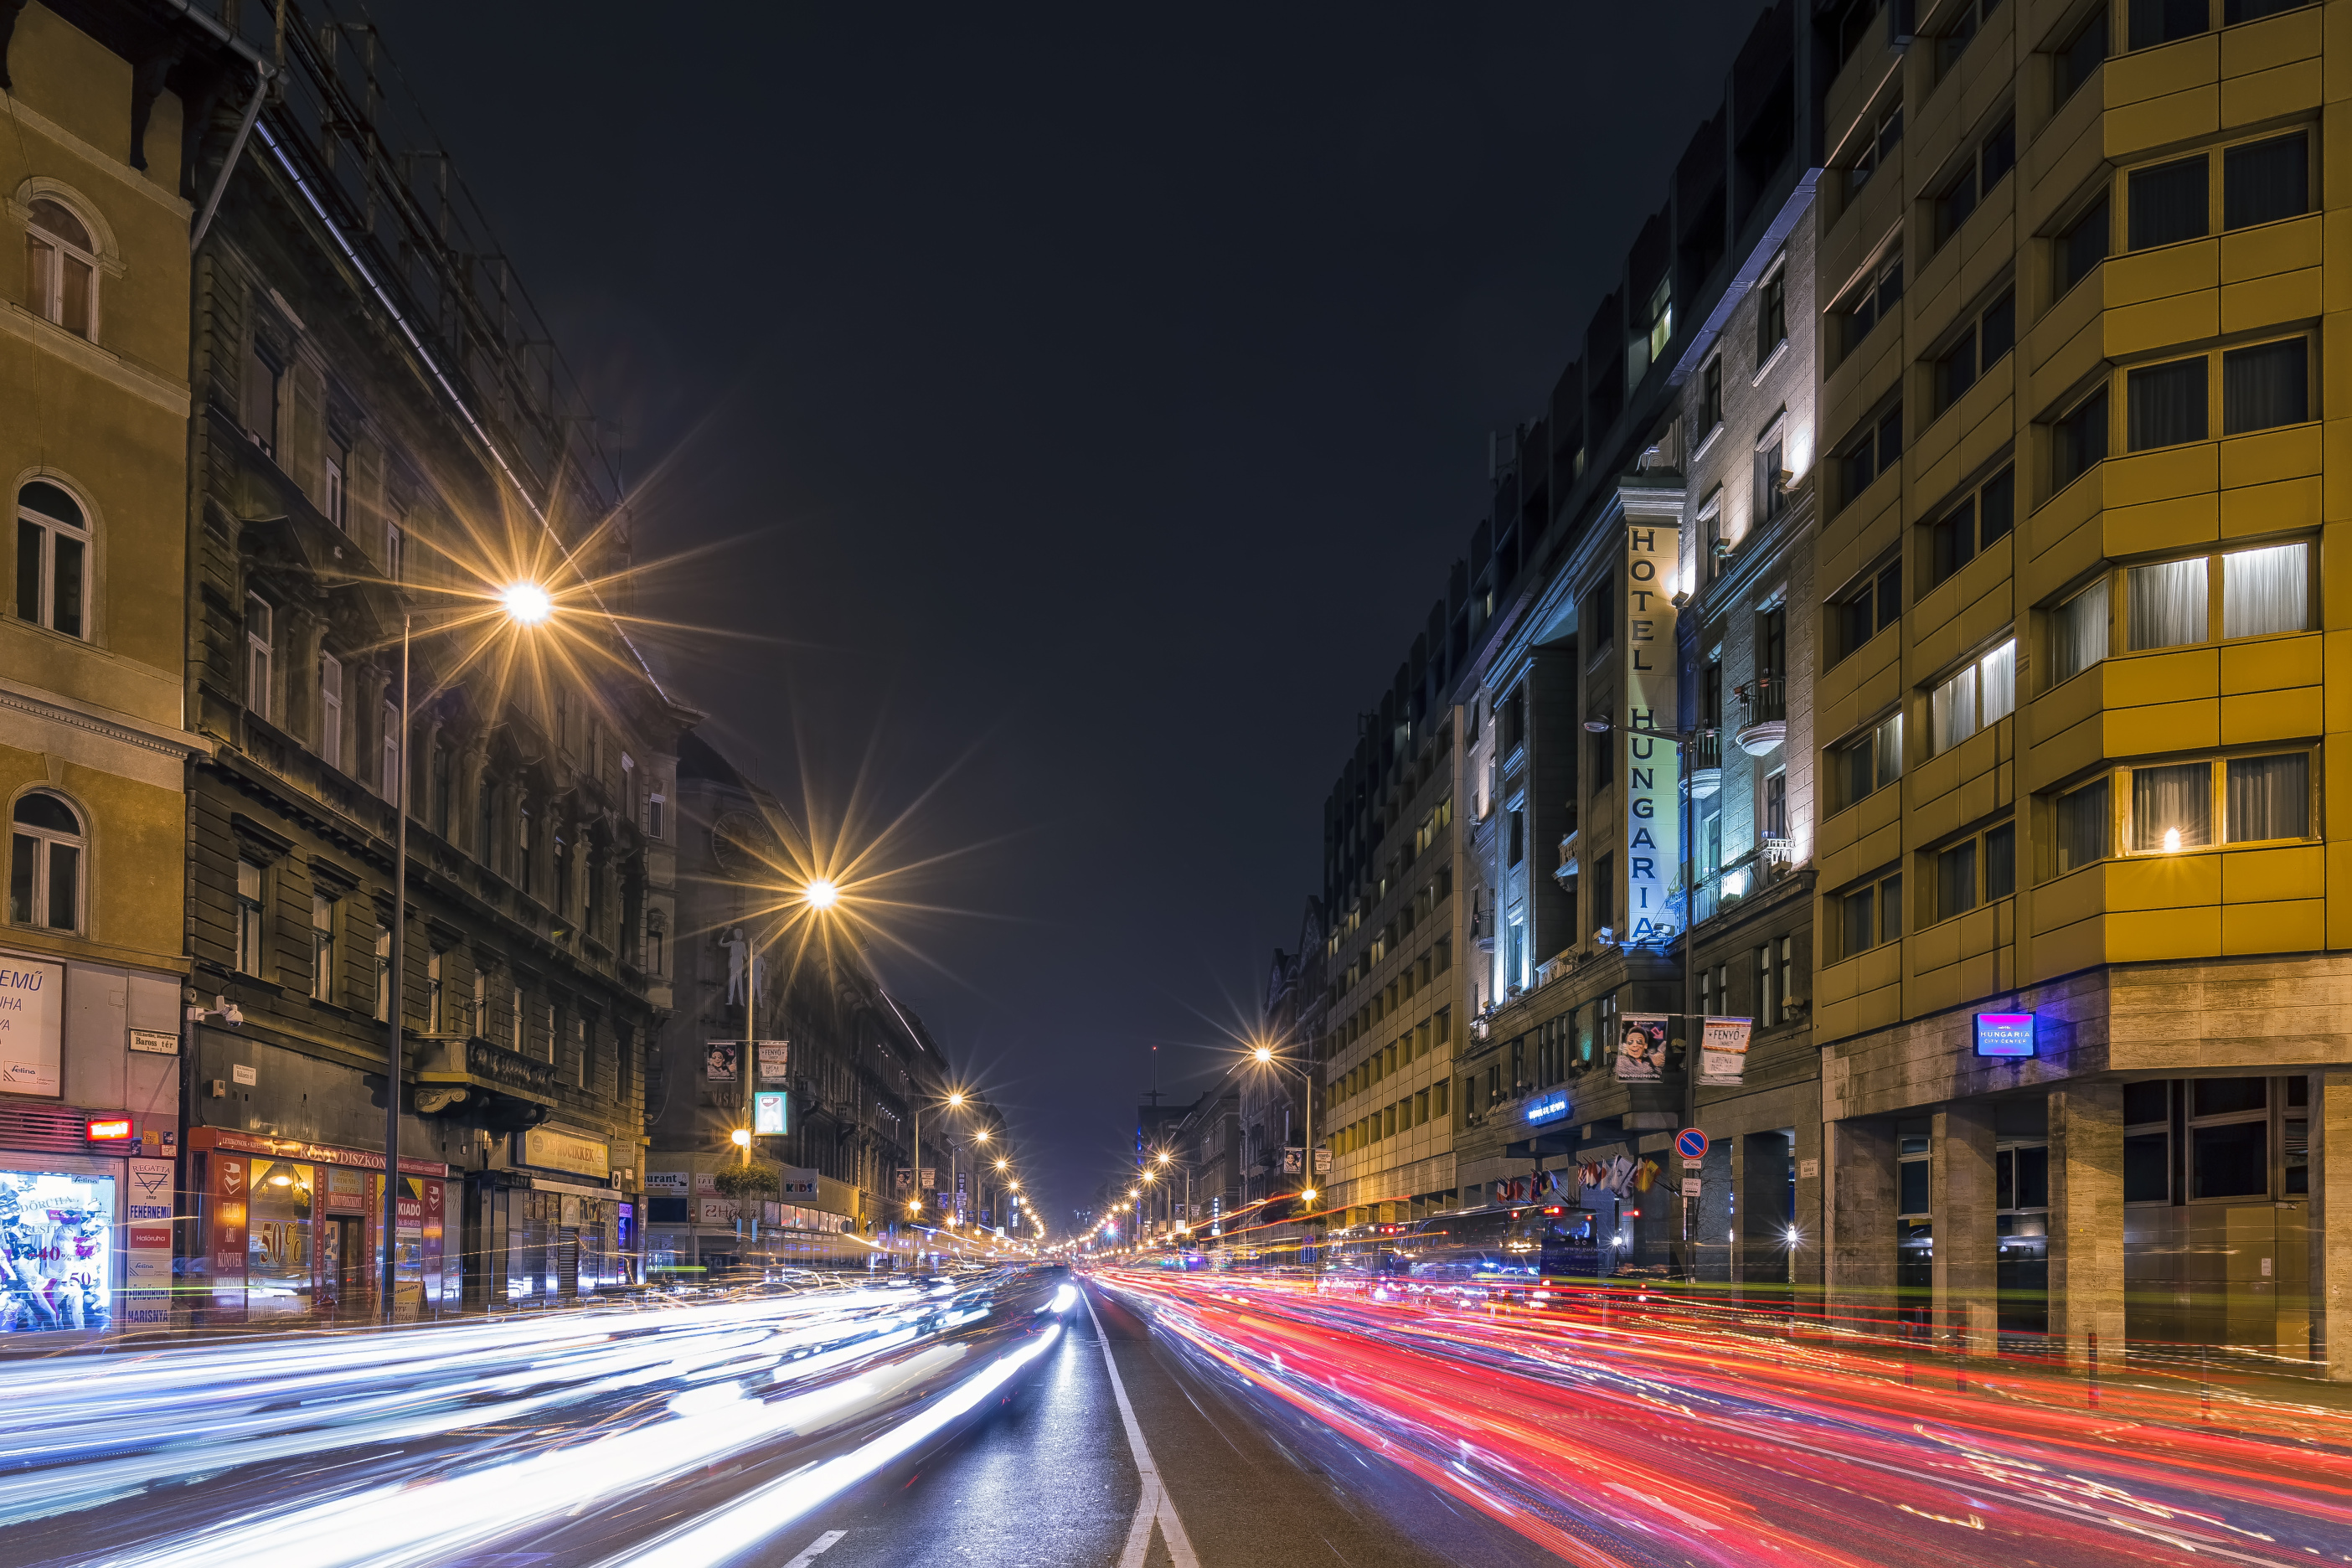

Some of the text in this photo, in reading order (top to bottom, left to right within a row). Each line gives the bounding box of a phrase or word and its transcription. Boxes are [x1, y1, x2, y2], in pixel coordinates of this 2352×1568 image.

[1631, 529, 1656, 671] HOTEL
[1630, 709, 1657, 939] HUNGARIA
[1713, 1028, 1740, 1040] FENYŐ
[136, 1037, 157, 1047] Baross
[300, 1144, 386, 1168] KÖNYVDISZKON
[547, 1138, 594, 1163] APRÓCIKKEK
[132, 1164, 170, 1173] REGATTA
[645, 1174, 677, 1183] urant
[786, 1183, 812, 1193] KIDS
[130, 1203, 172, 1219] FEHÉRNEMŰ
[222, 1203, 240, 1220] TELJES
[398, 1202, 421, 1217] KIADÓ
[28, 1246, 72, 1261] -40%
[218, 1249, 243, 1267] KÖNYVEK
[395, 1285, 419, 1294] ZÁCIÓS
[127, 1309, 169, 1323] HARISNYA
